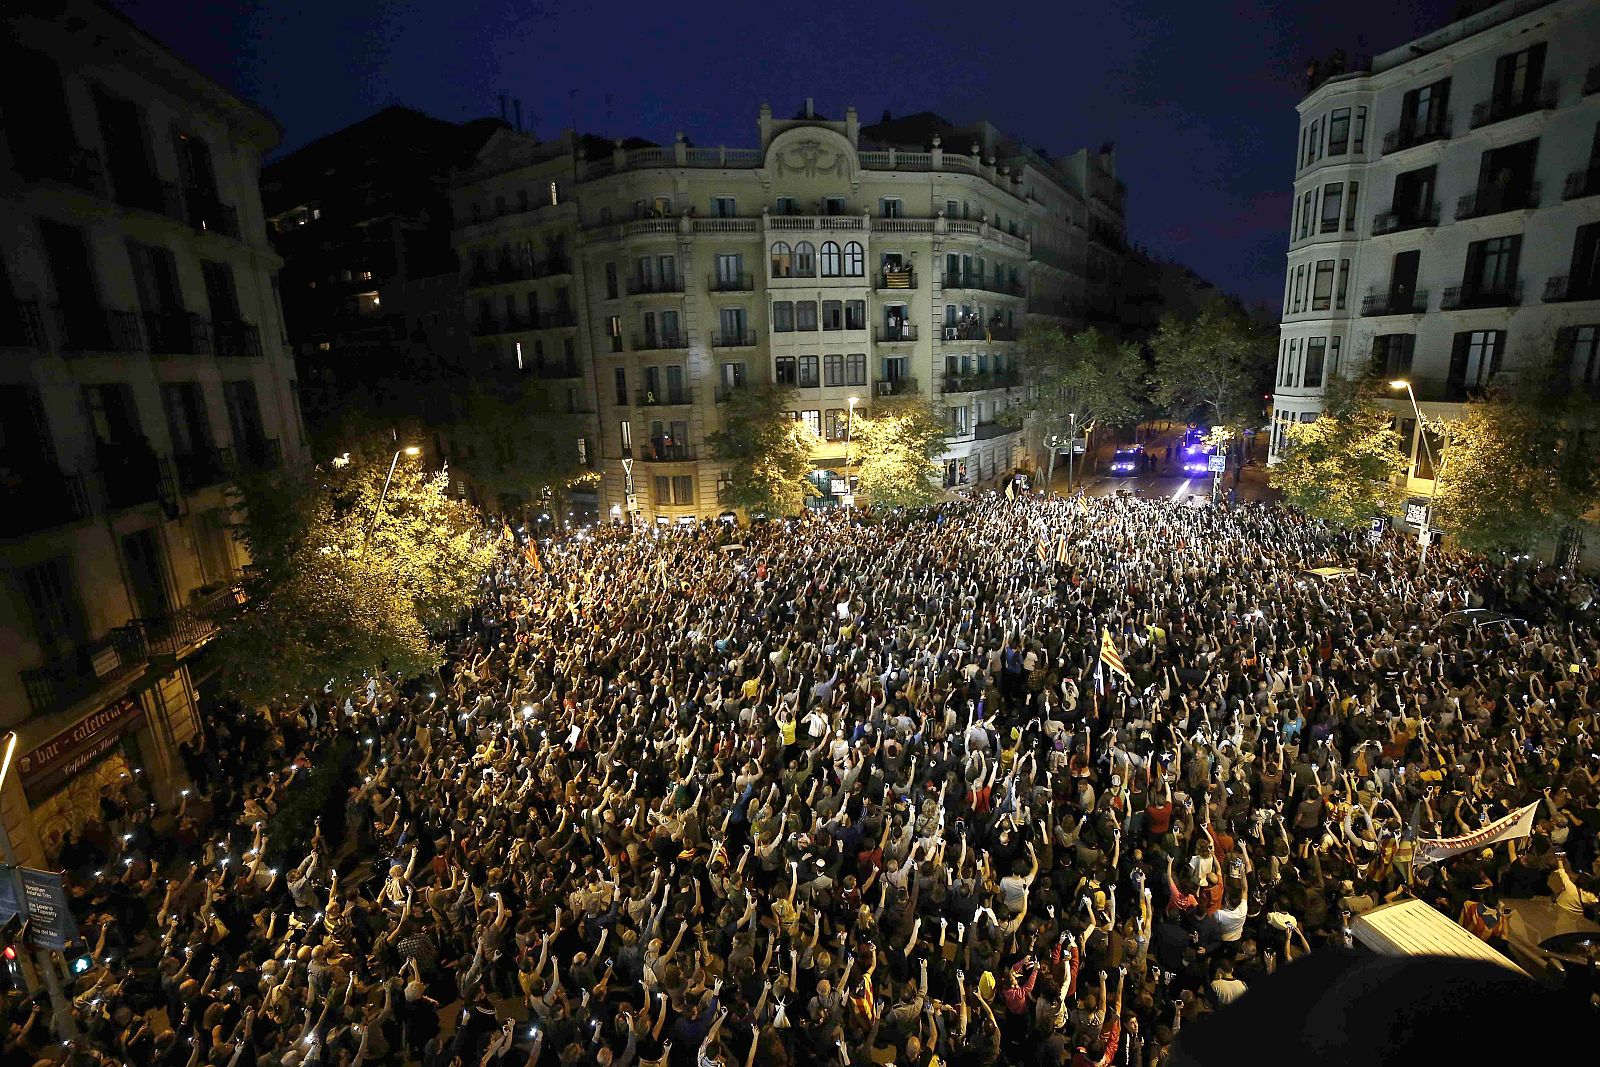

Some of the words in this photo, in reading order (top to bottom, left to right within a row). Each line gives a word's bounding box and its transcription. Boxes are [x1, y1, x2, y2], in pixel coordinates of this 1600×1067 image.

[1372, 519, 1381, 531] P
[36, 742, 59, 764] bar
[73, 704, 121, 742] cafeteria
